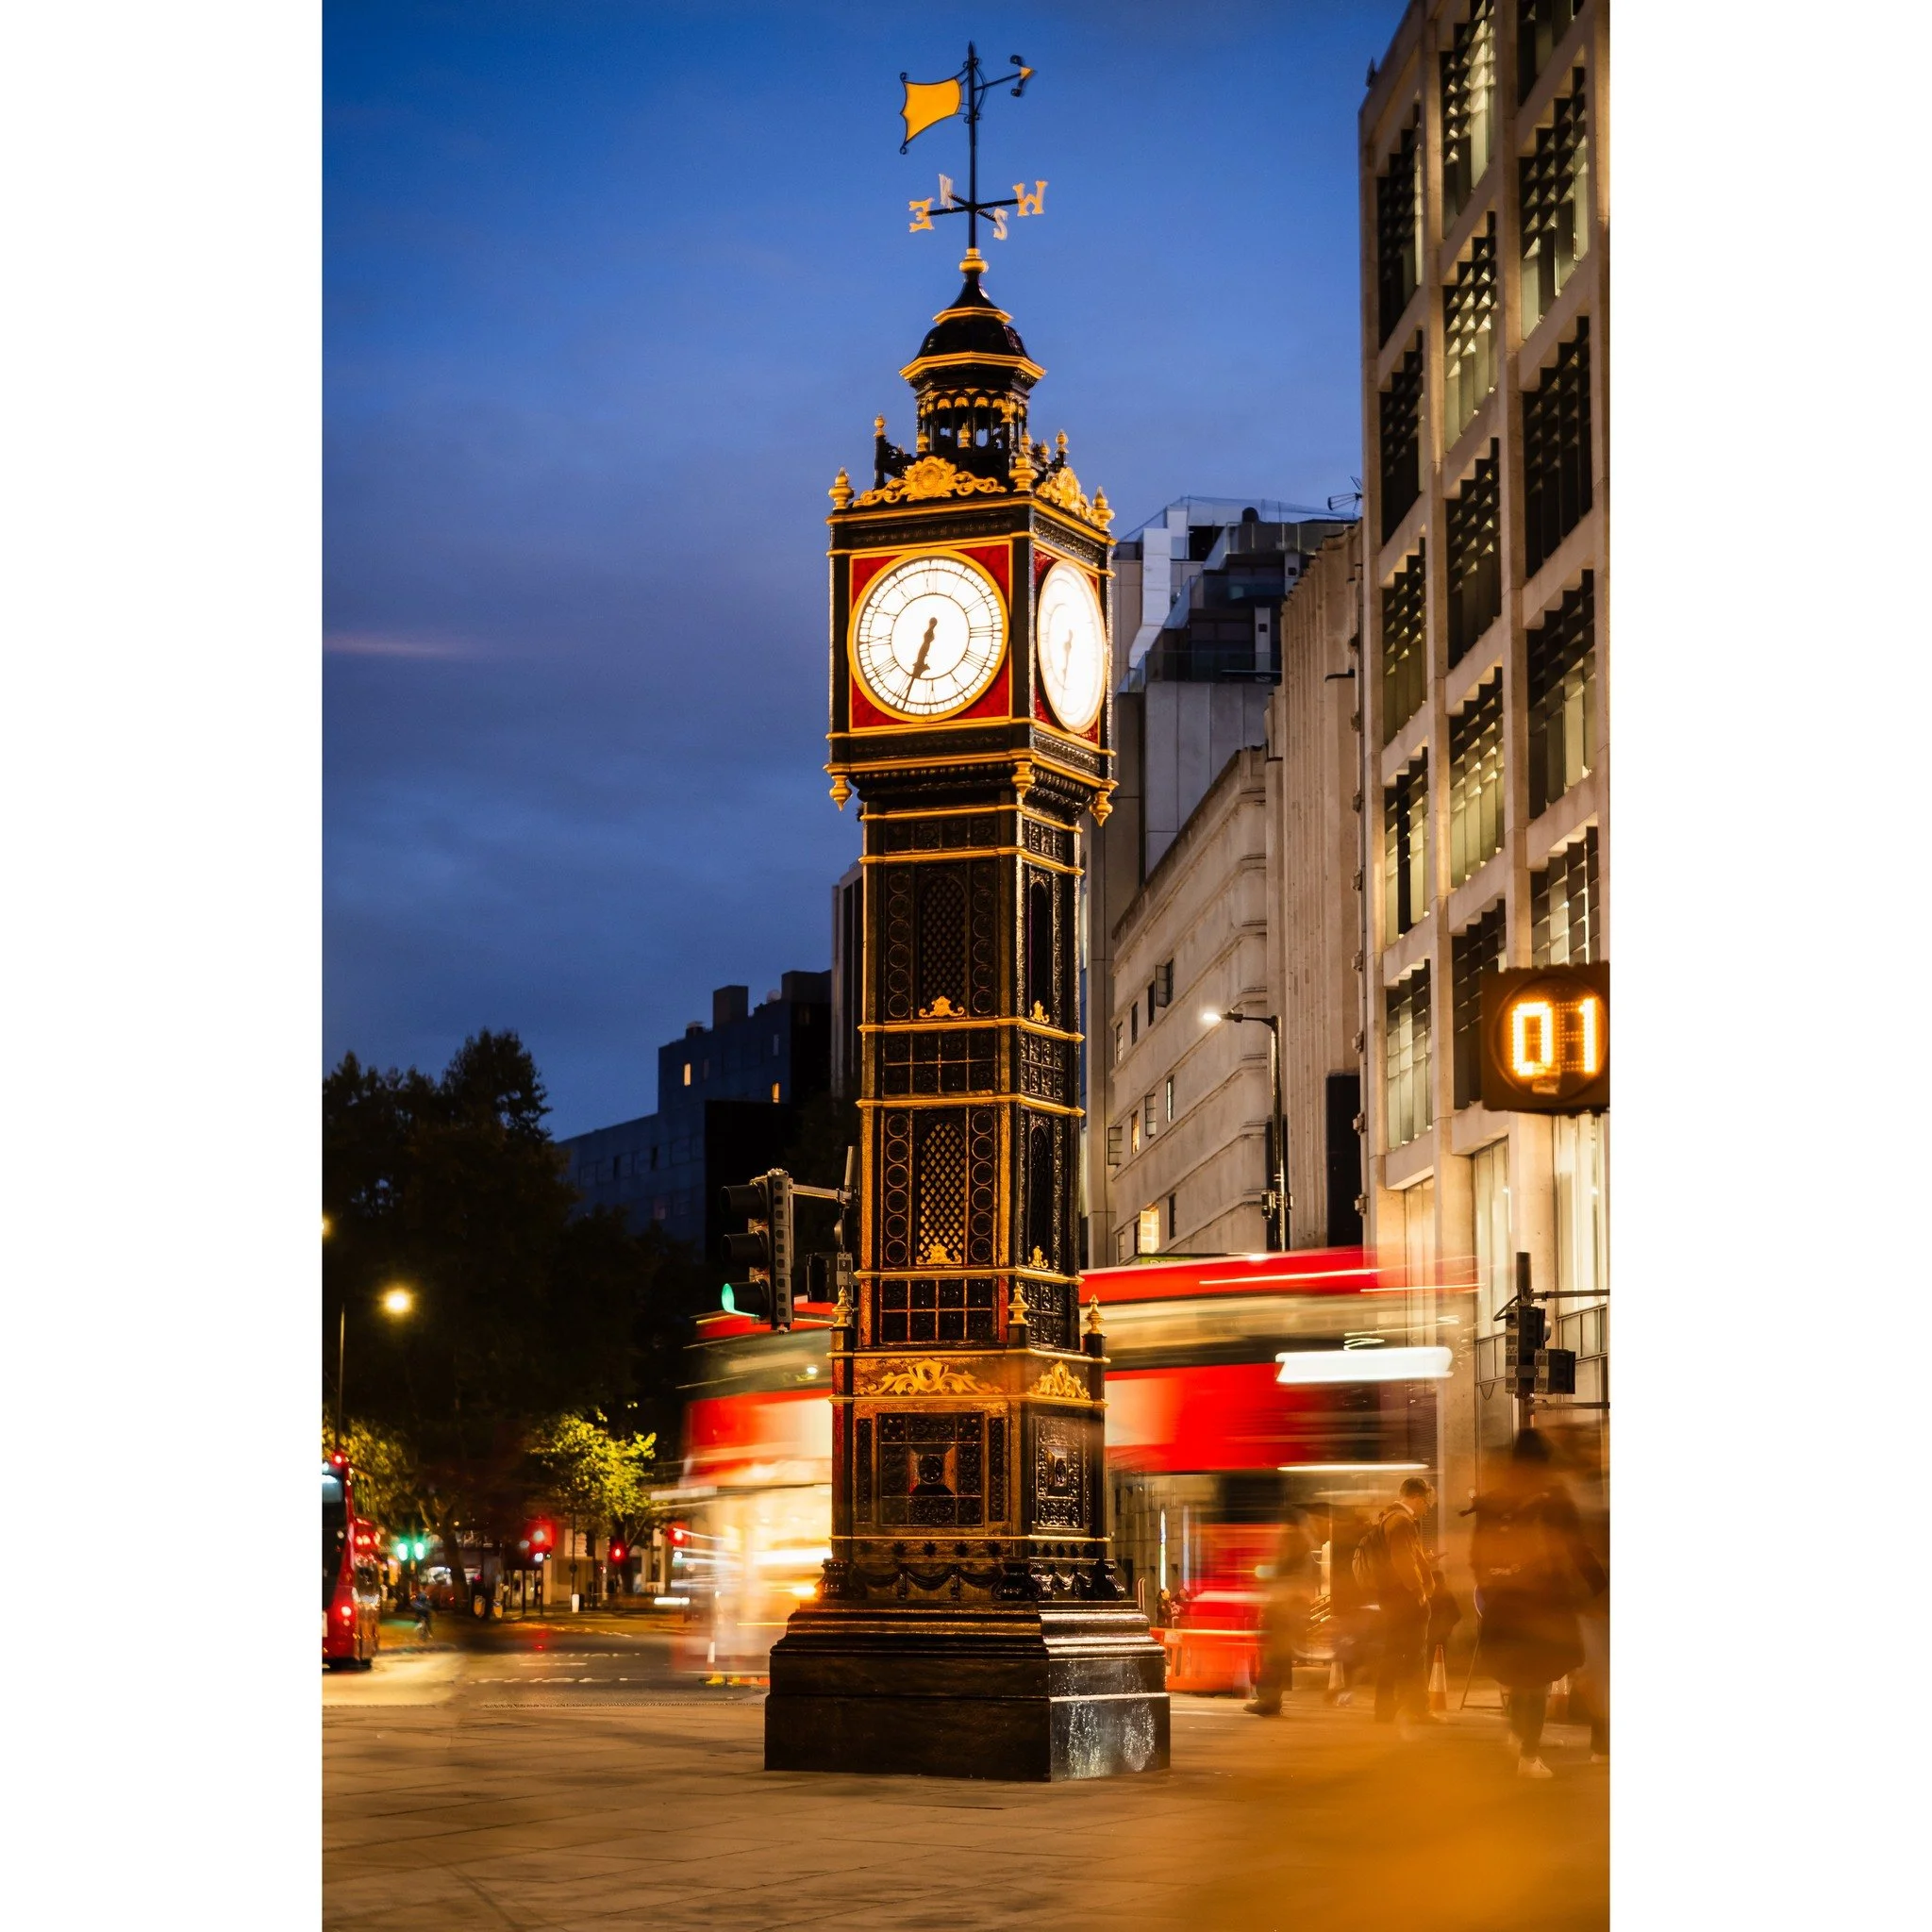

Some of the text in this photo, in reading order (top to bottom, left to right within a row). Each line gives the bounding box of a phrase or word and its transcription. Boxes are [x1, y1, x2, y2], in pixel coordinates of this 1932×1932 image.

[1012, 180, 1048, 217] W
[993, 208, 1008, 241] S
[1512, 996, 1597, 1077] 01
